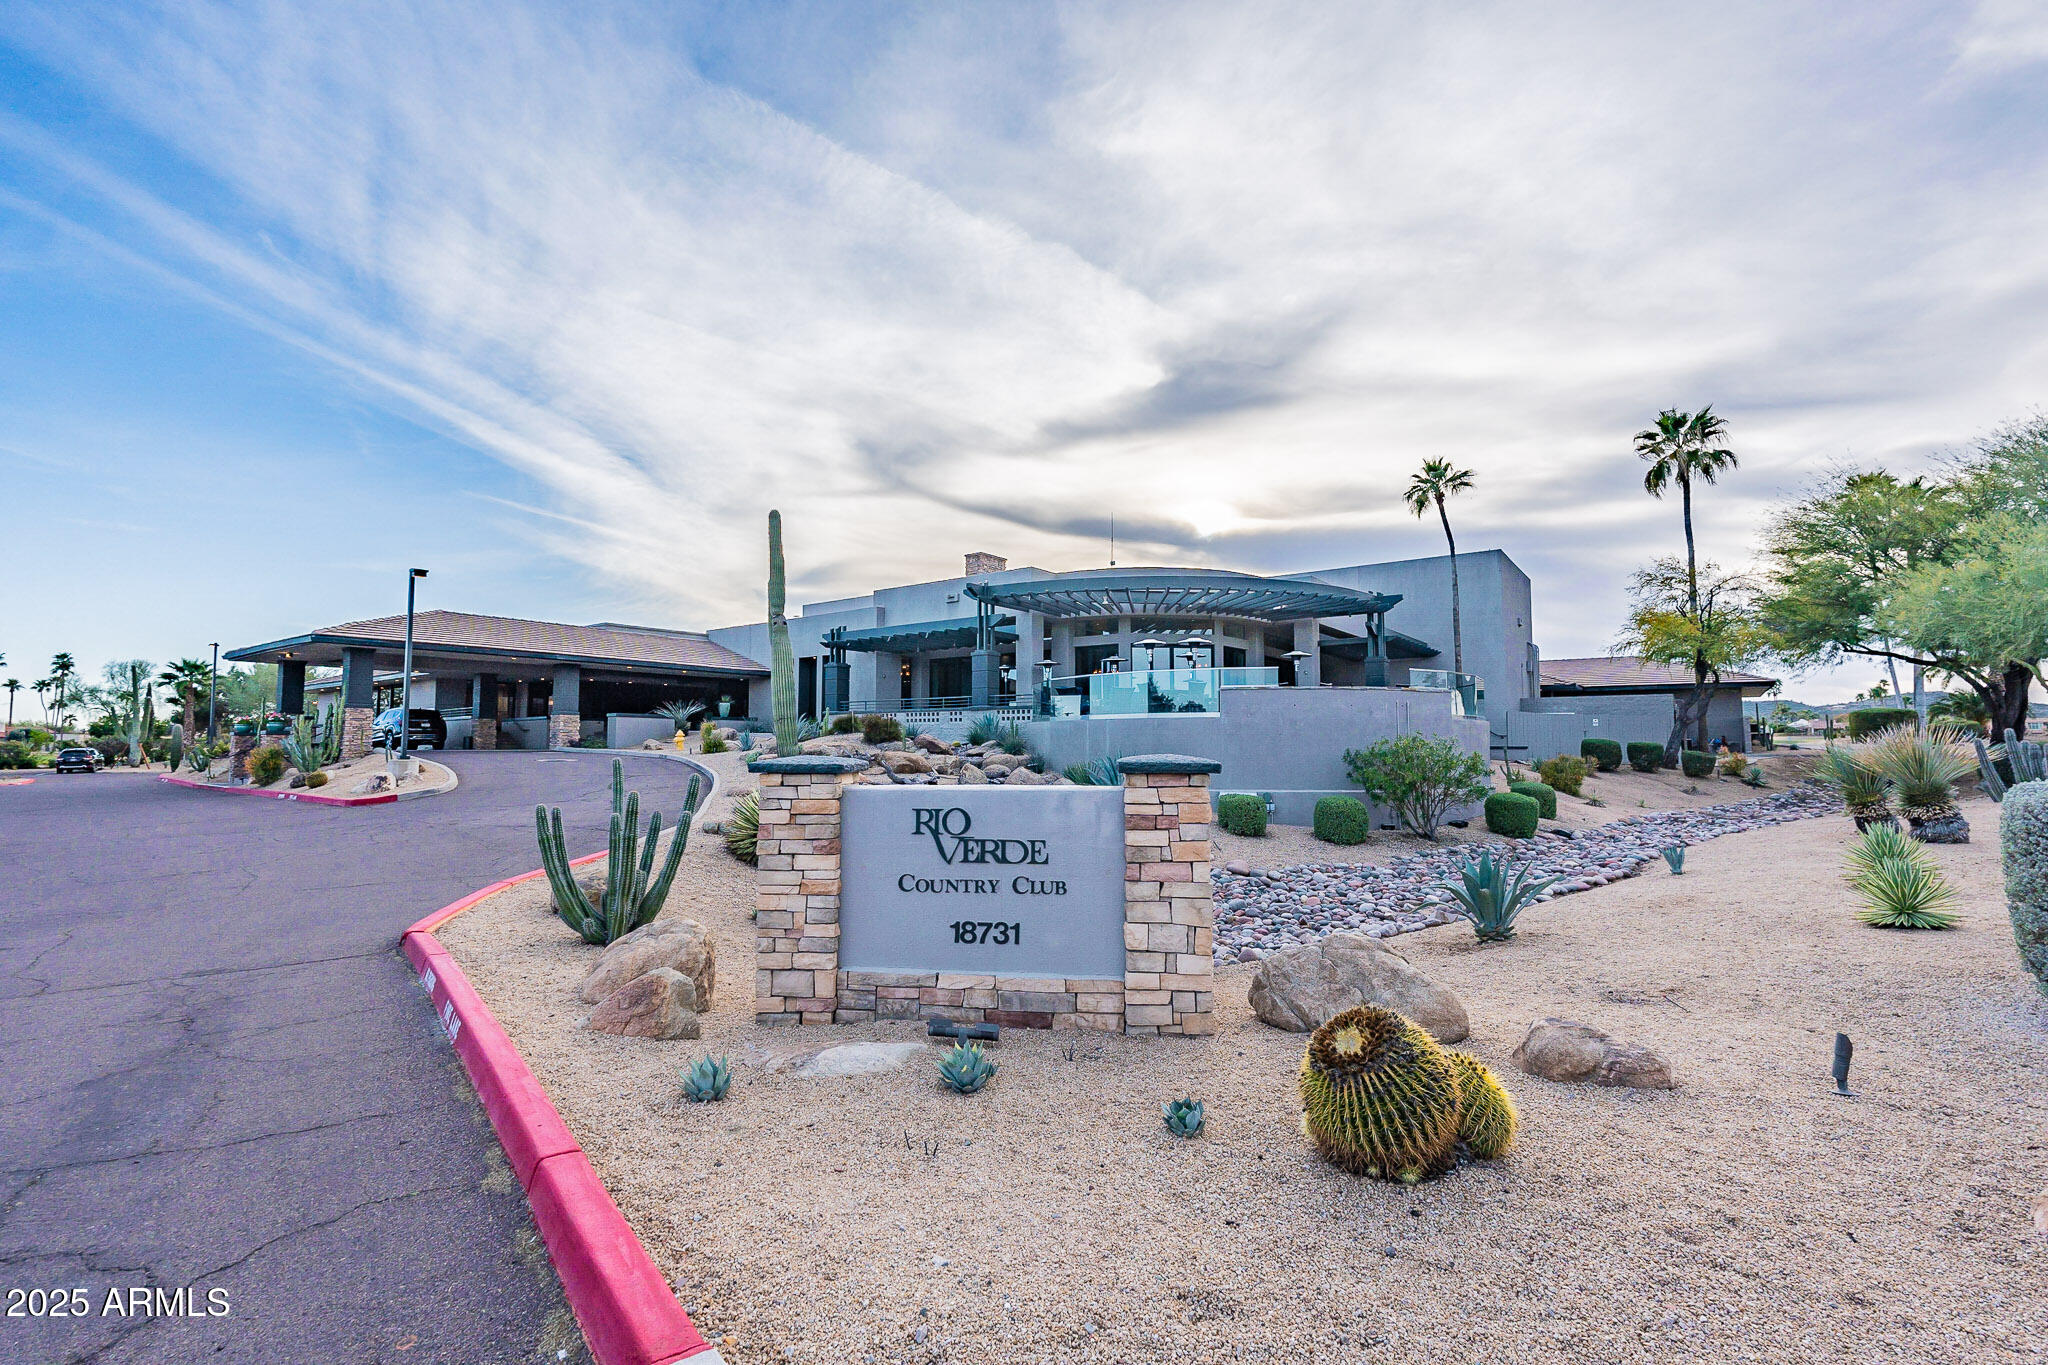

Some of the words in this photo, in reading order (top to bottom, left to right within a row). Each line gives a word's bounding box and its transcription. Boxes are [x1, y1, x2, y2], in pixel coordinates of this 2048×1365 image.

[911, 807, 972, 836] RIO
[932, 835, 1049, 865] VERDE
[898, 873, 1001, 894] COUNTRY
[1012, 876, 1068, 895] CLUB
[949, 920, 1021, 945] 18731
